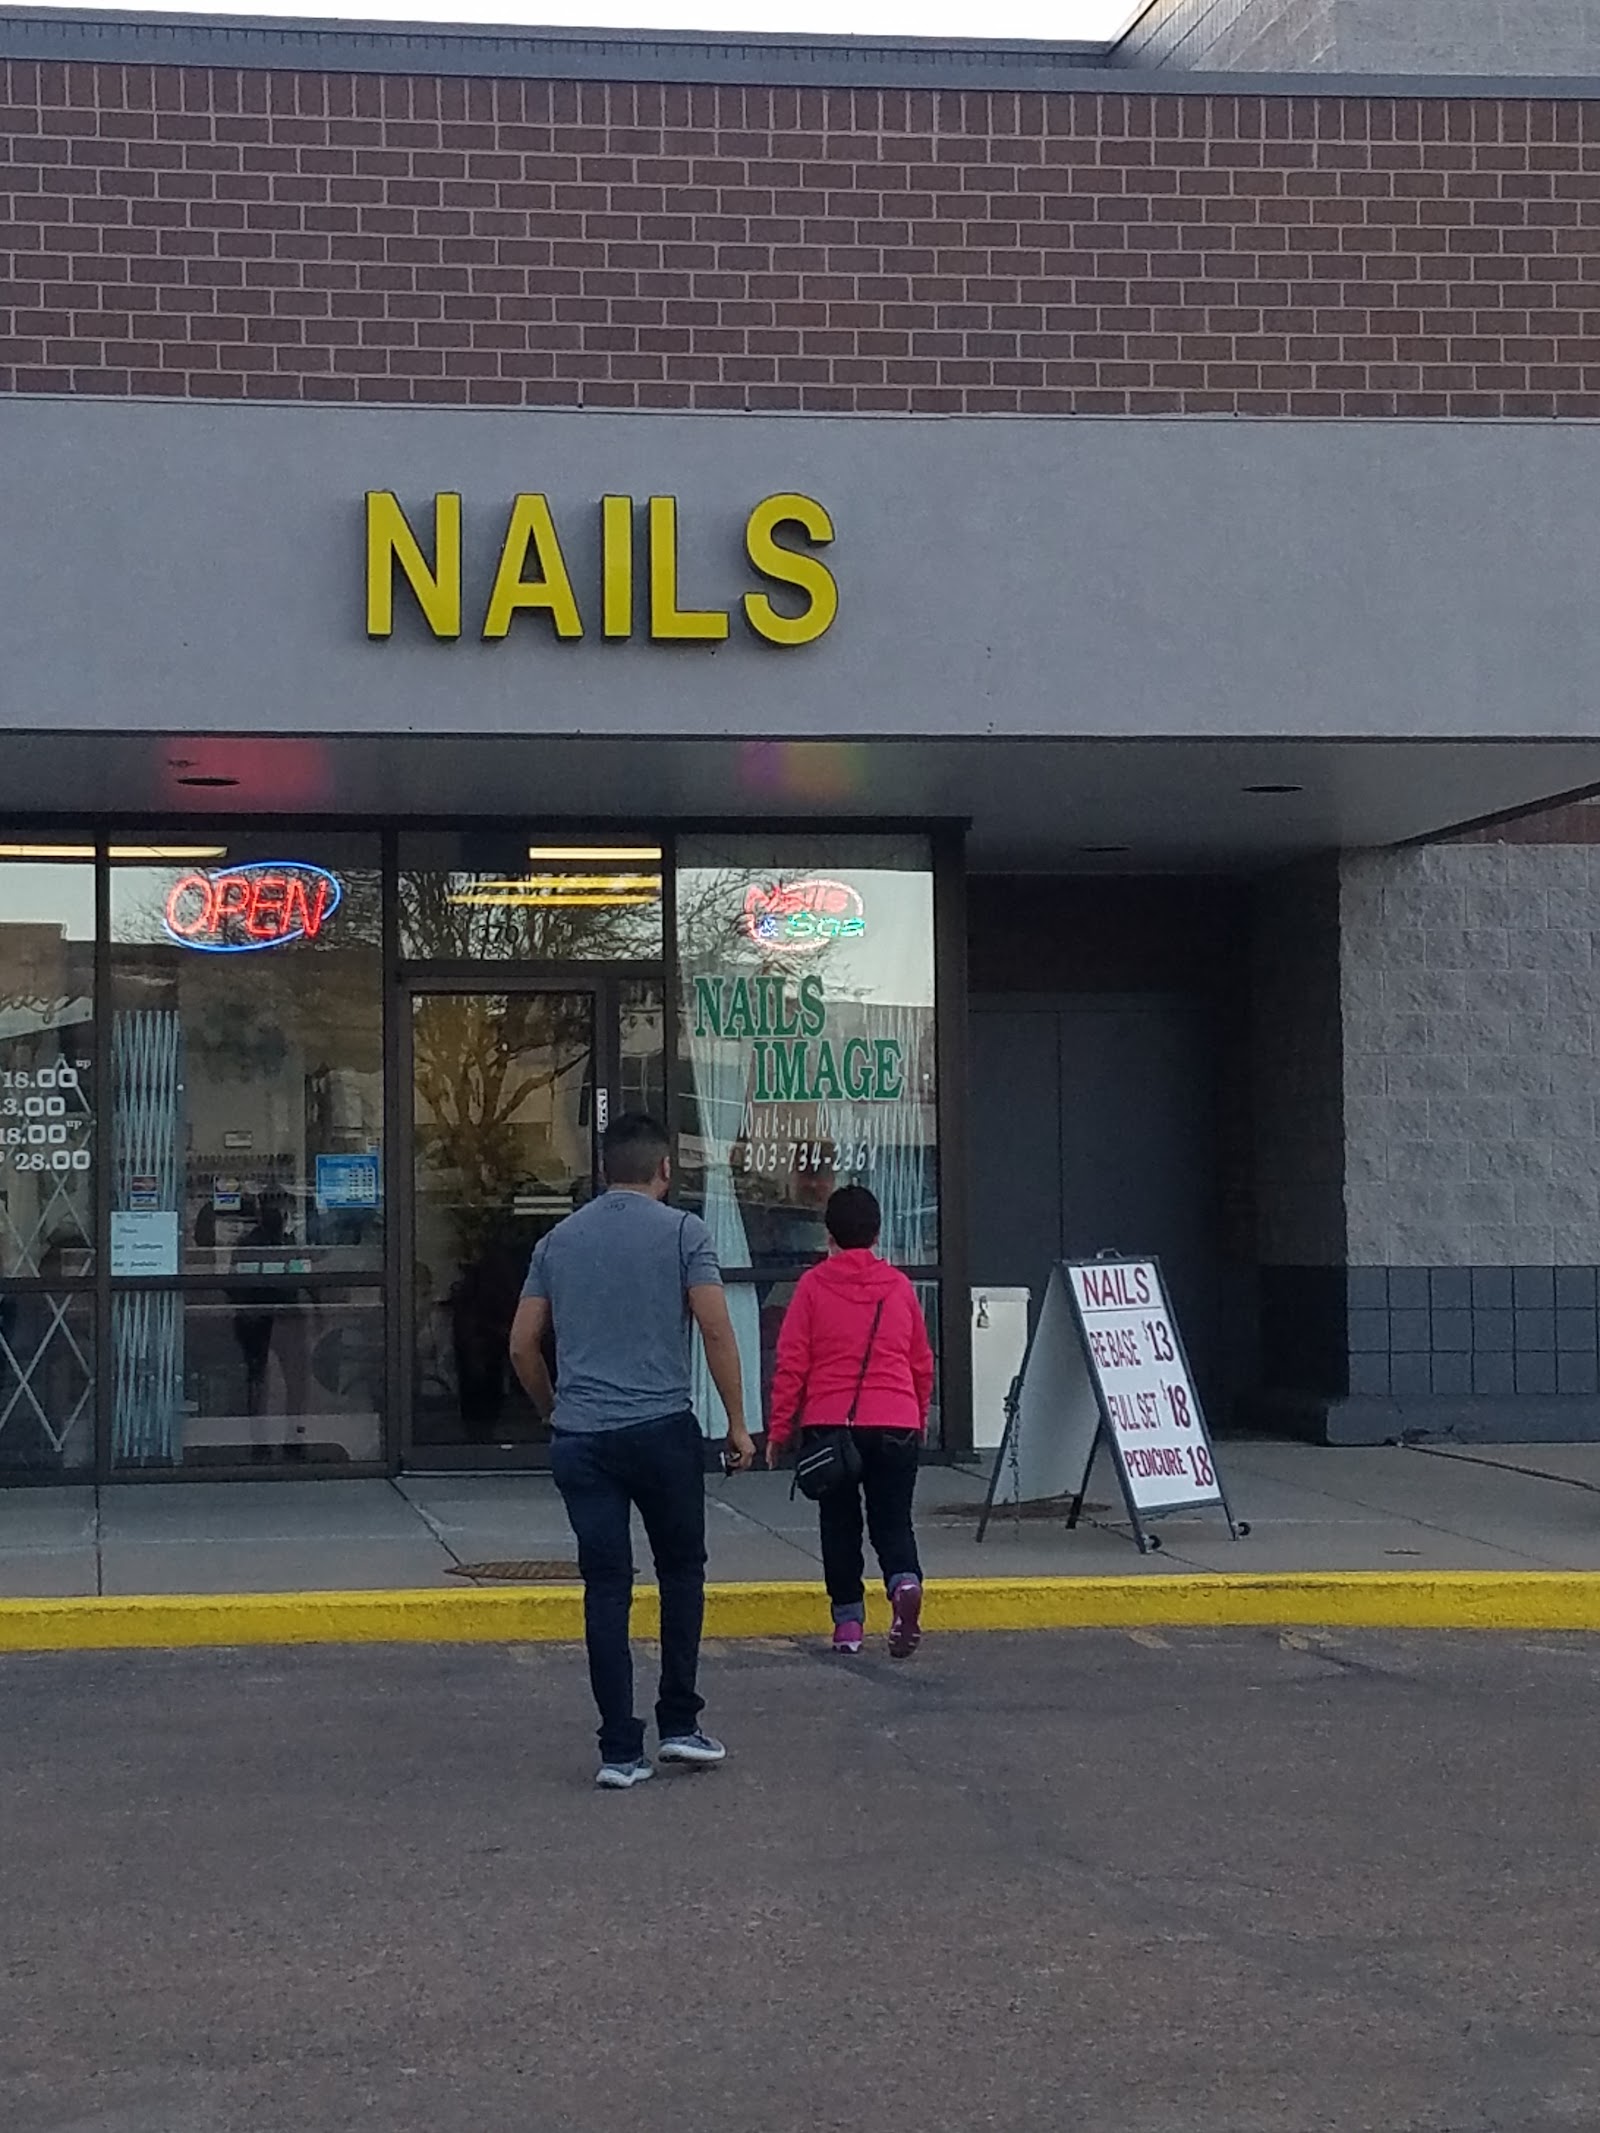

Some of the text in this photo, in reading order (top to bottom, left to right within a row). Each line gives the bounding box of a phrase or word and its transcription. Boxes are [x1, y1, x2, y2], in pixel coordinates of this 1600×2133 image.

[365, 490, 838, 645] NAILS
[166, 875, 329, 938] OPEN
[693, 974, 826, 1038] NAILS
[752, 1037, 904, 1102] IMAGE
[0, 1096, 66, 1117] 3.00
[815, 1102, 880, 1140] Welom
[15, 1150, 91, 1171] 28.00
[1080, 1266, 1151, 1307] NAILS
[1107, 1395, 1141, 1432] FULL
[1136, 1392, 1162, 1430] SET
[1123, 1445, 1214, 1487] PEDICURE 18
